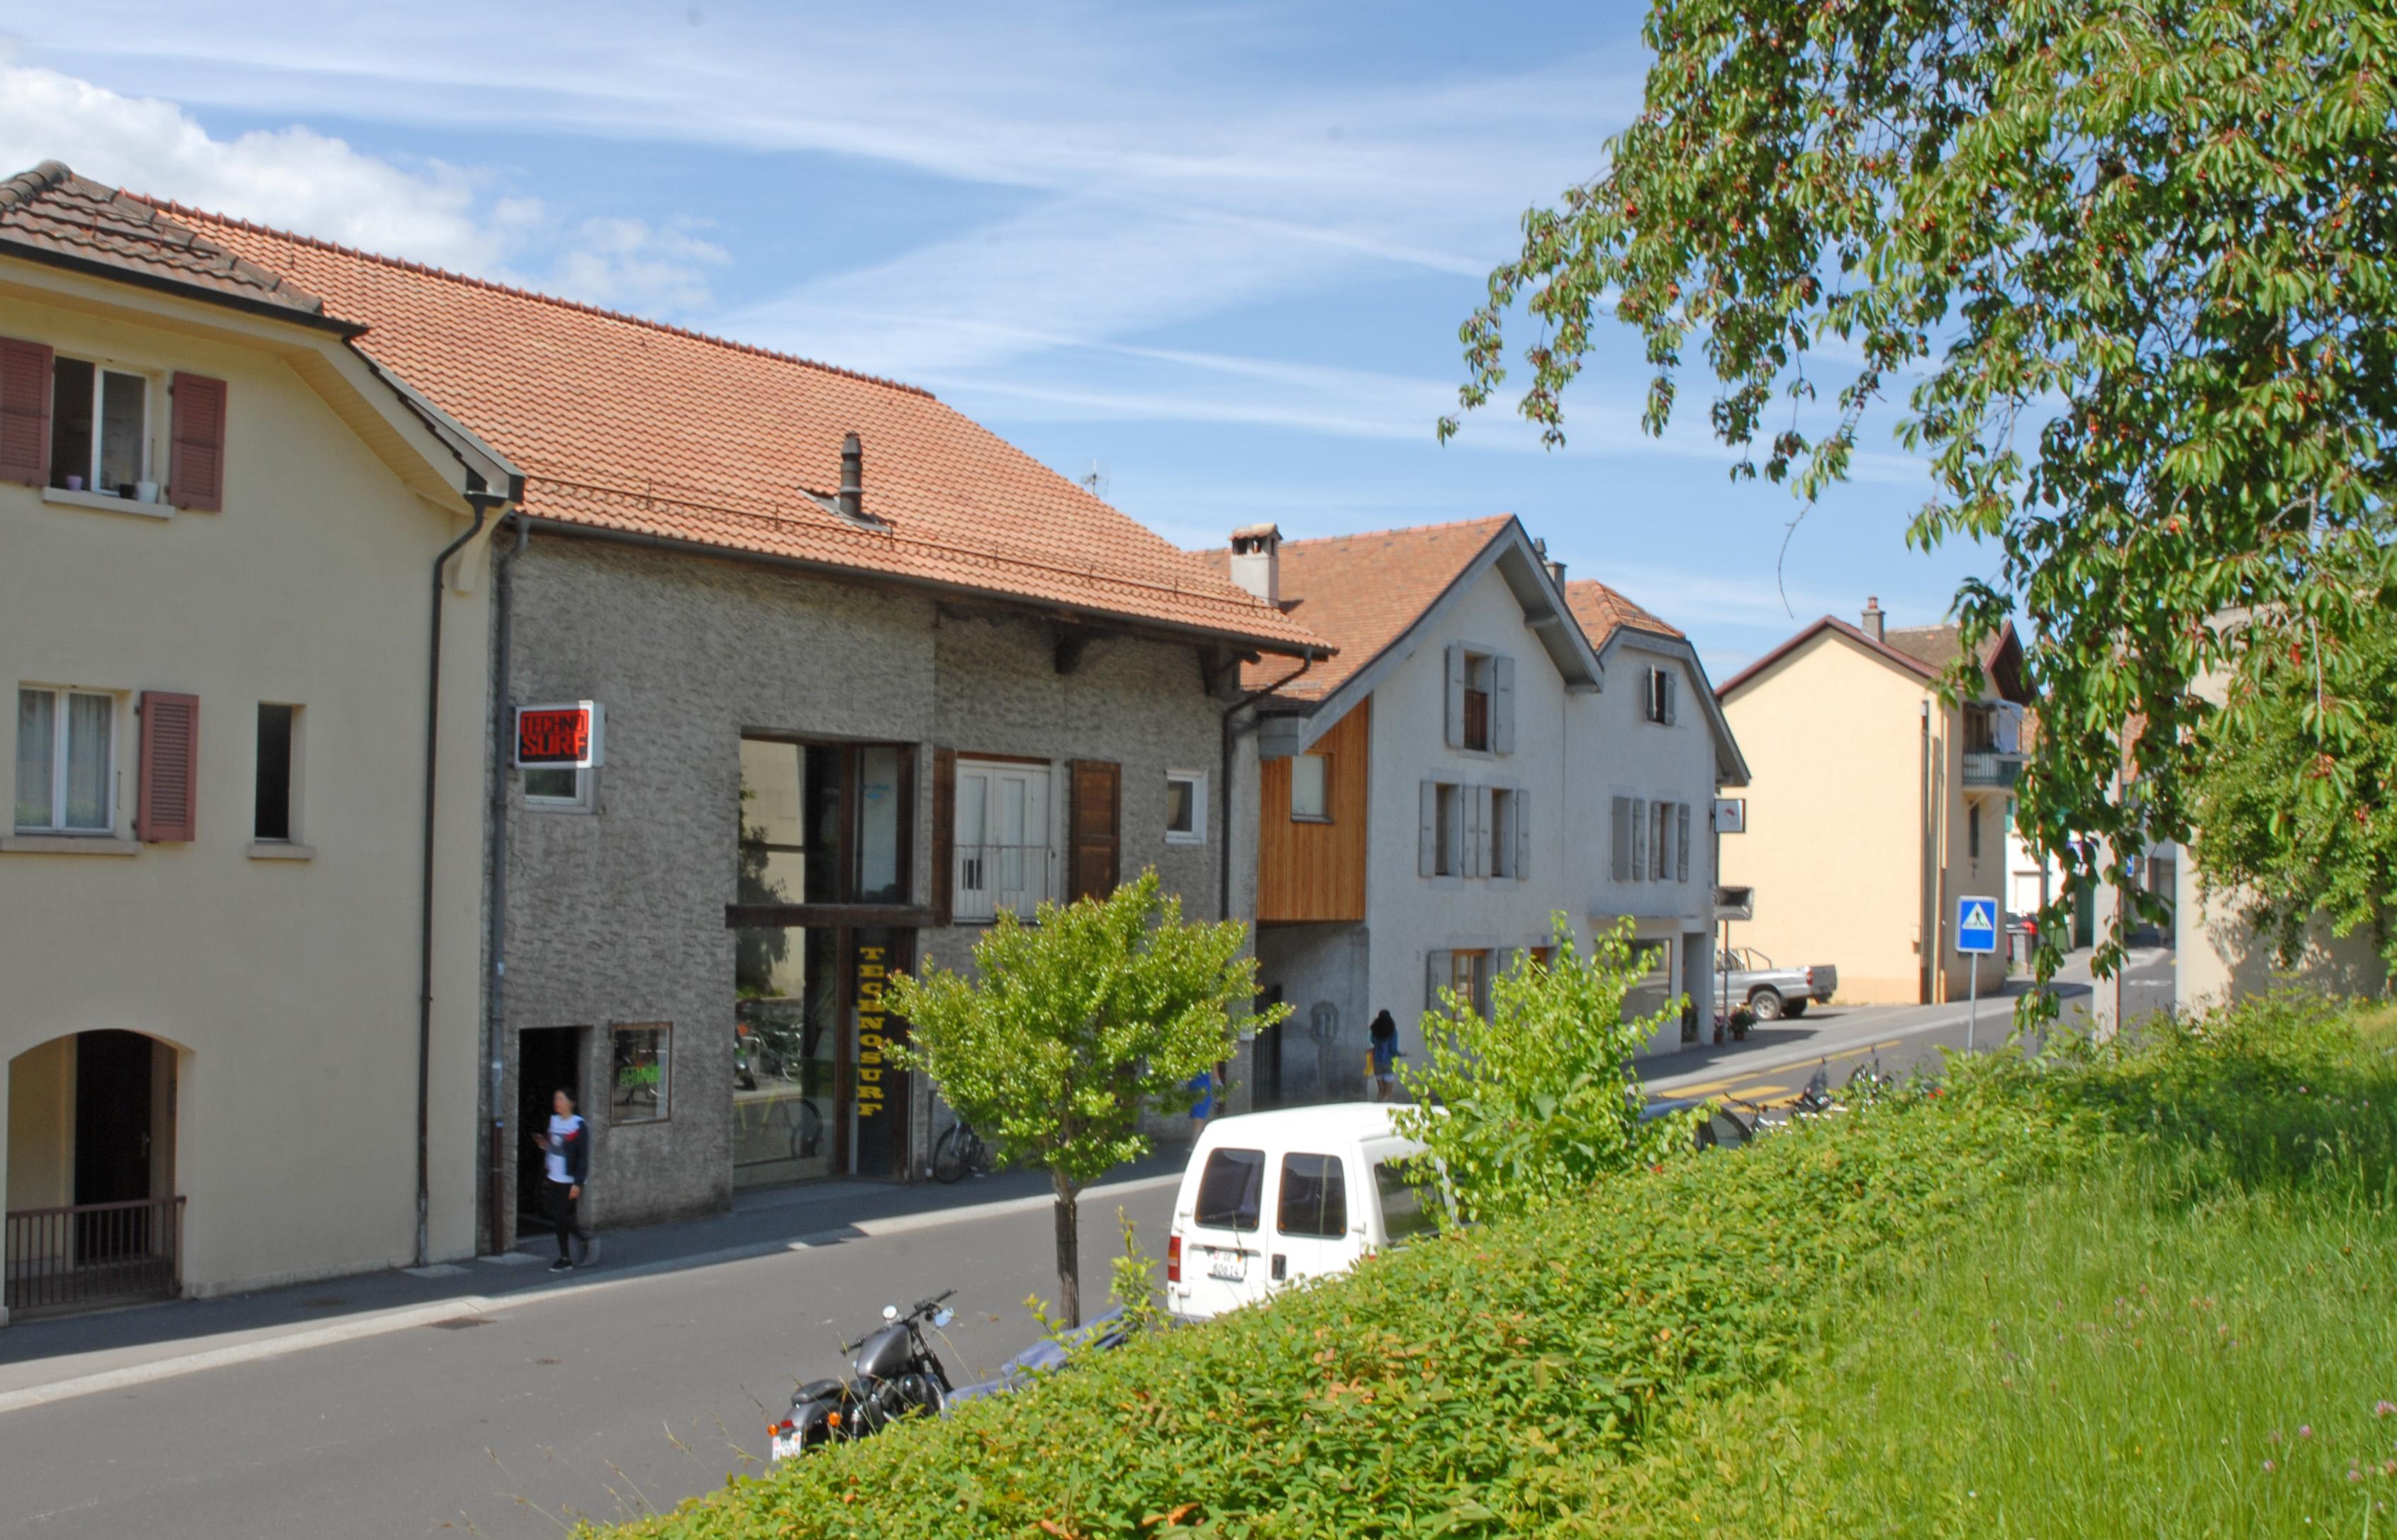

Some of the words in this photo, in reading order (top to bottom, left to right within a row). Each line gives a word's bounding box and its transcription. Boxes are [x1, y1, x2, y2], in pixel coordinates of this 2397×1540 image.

[523, 714, 585, 734] TECHNO
[522, 733, 586, 756] SURF
[856, 946, 886, 1117] TECHNOSURF
